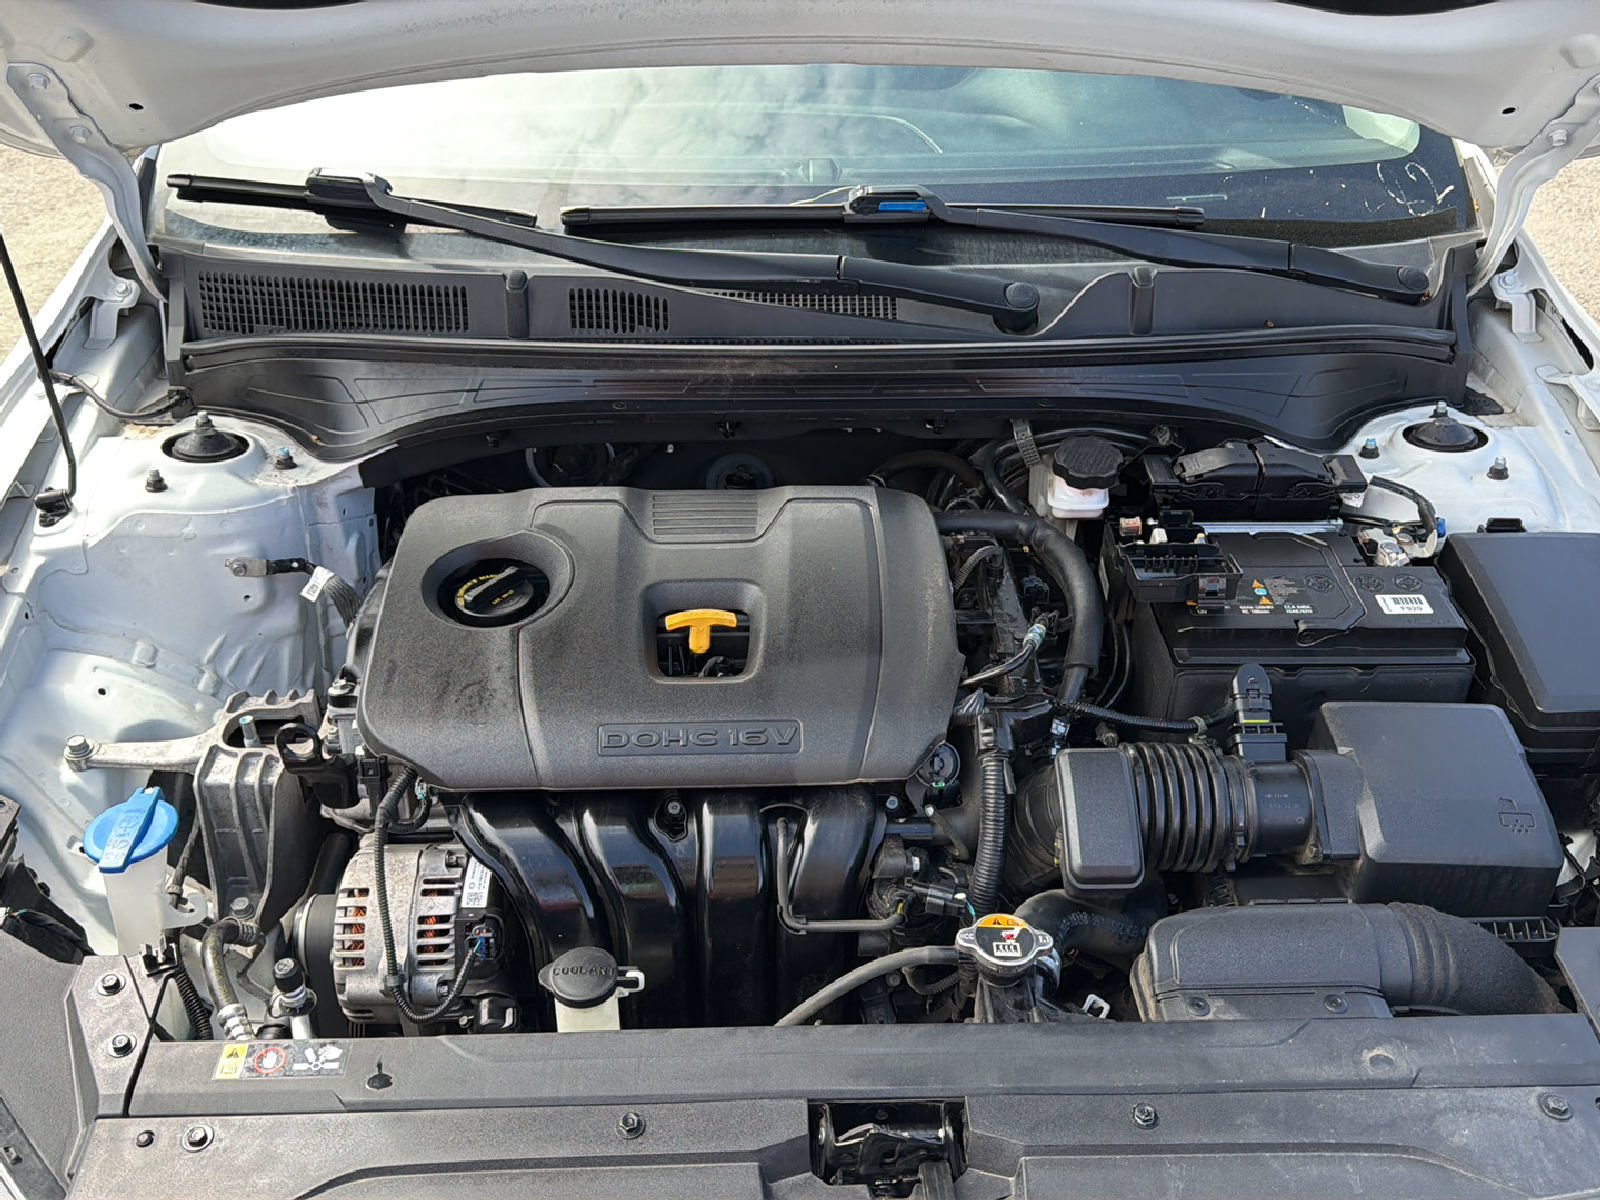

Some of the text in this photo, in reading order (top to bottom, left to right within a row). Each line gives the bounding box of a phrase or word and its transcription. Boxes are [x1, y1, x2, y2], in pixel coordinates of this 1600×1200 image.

[602, 726, 798, 748] DOHC 16V
[553, 965, 615, 976] COOLANT
